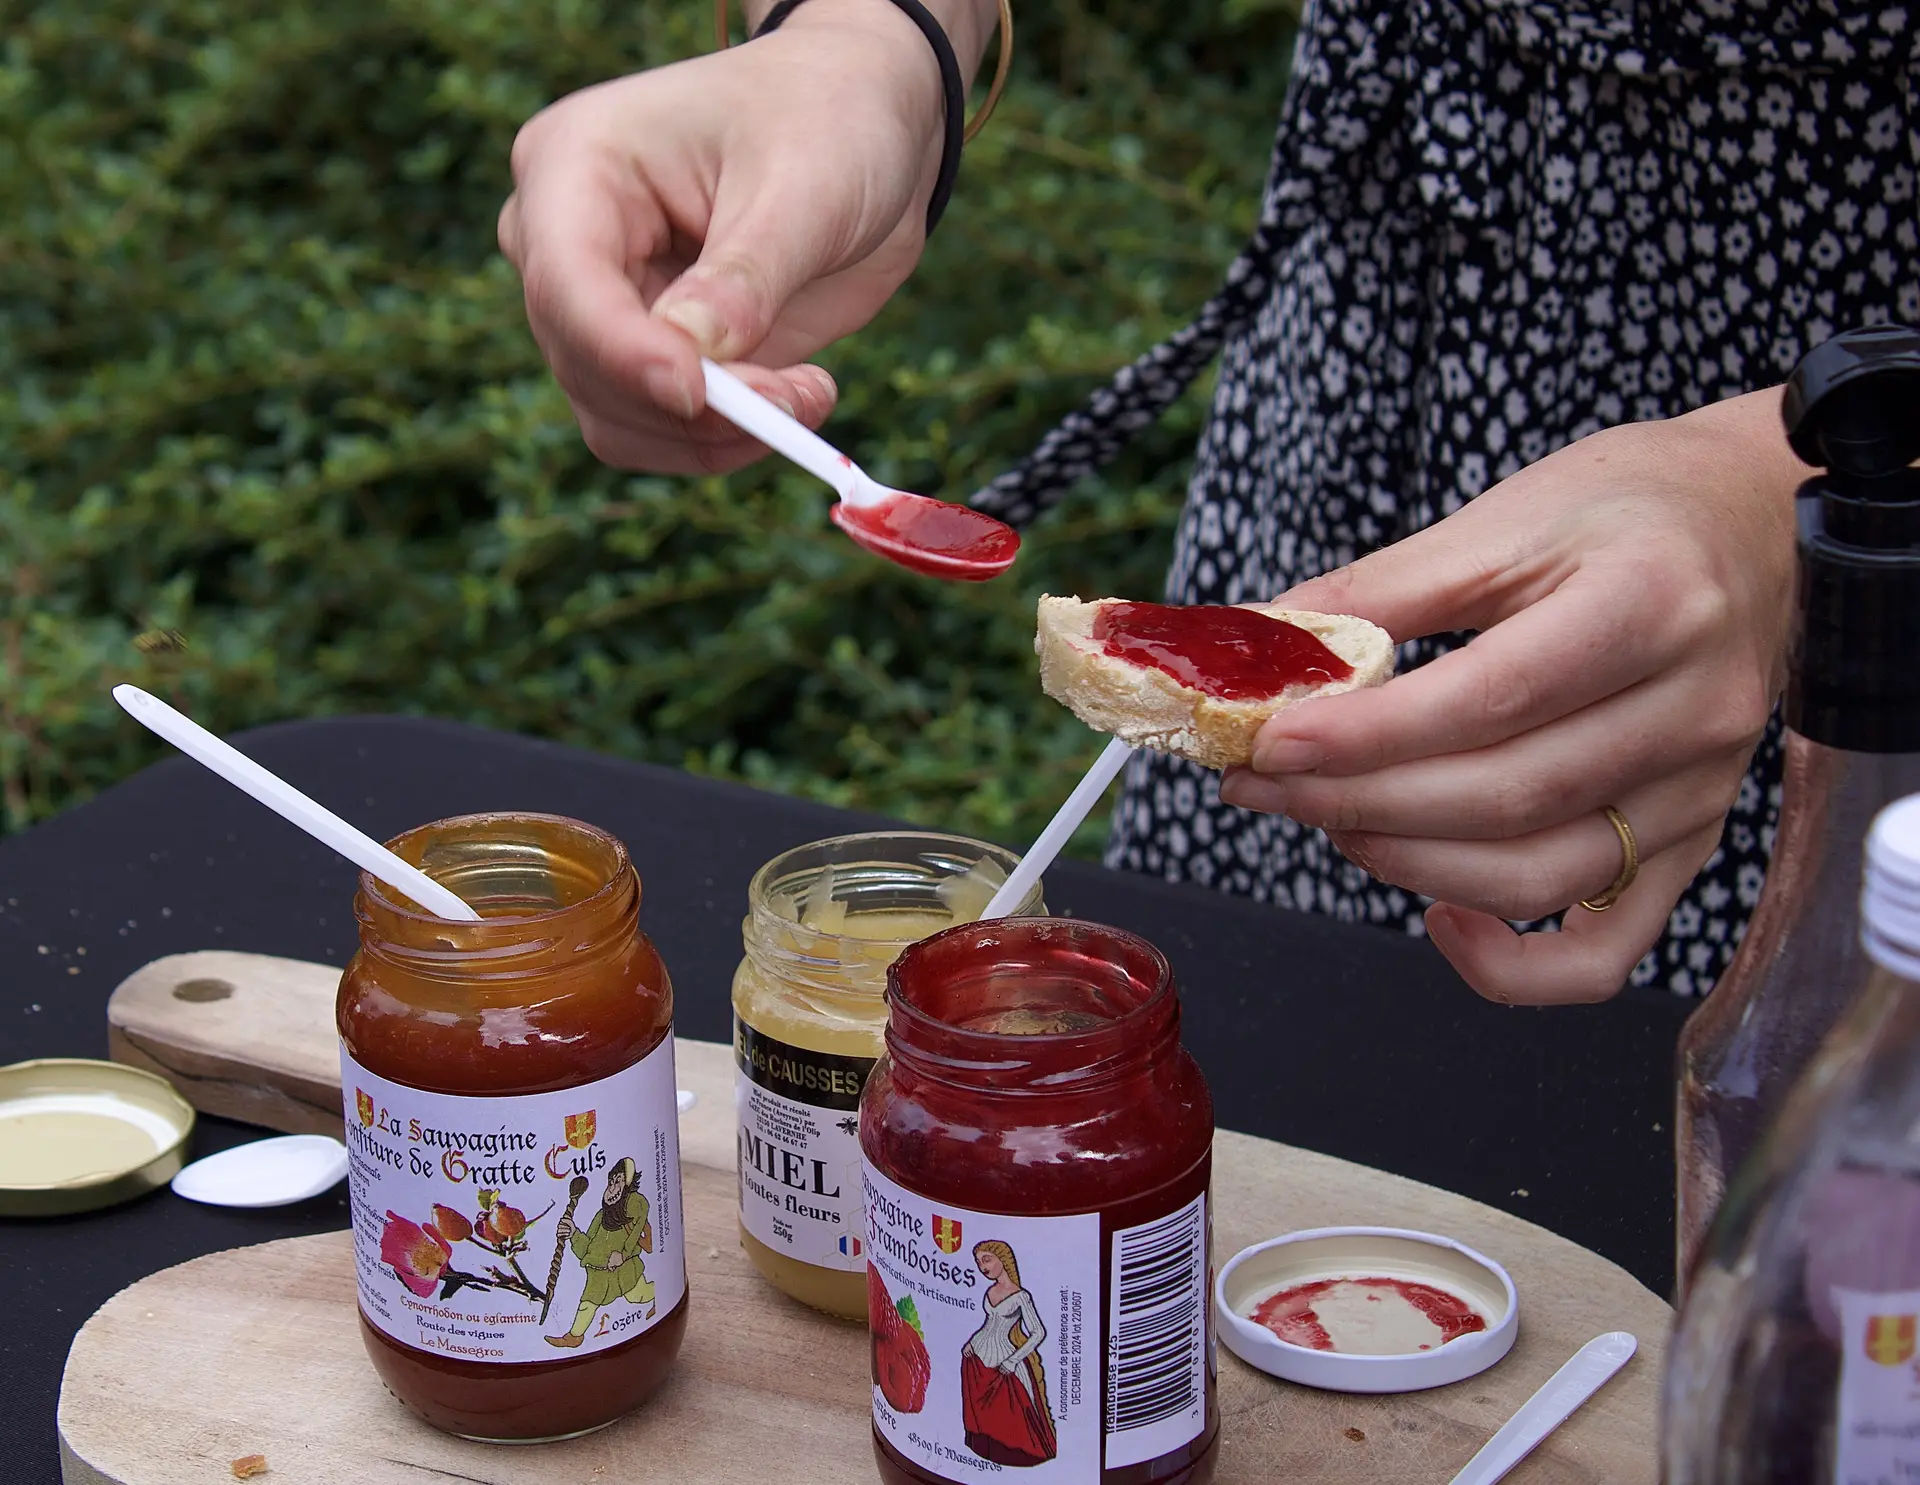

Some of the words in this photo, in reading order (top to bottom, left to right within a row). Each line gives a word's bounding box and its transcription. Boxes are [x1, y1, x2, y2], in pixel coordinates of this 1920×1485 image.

[751, 1045, 766, 1072] de
[768, 1053, 860, 1096] CAUSSES
[756, 1098, 772, 1112] France
[773, 1108, 803, 1125] (Aveyron)
[804, 1120, 815, 1129] par
[763, 1096, 781, 1109] produit
[789, 1107, 811, 1117] récolté
[377, 1108, 402, 1137] La
[408, 1118, 537, 1157] Sauvagine
[771, 1122, 807, 1141] LAVERNHE
[793, 1122, 801, 1131] de
[409, 1147, 433, 1178] de
[441, 1149, 536, 1184] Gratte
[544, 1143, 606, 1180] Culs
[743, 1125, 840, 1199] MIEL
[745, 1171, 780, 1207] toutes
[785, 1194, 841, 1224] fleurs
[863, 1171, 924, 1237] auvagine
[773, 1224, 793, 1243] 250g
[917, 1282, 976, 1311] Artisanale
[1060, 1289, 1069, 1312] avant
[1071, 1291, 1082, 1323] 22/0607
[416, 1314, 446, 1333] Route
[447, 1325, 466, 1337] des
[466, 1313, 480, 1323] ou
[593, 1310, 642, 1338] Lozère
[1071, 1324, 1081, 1334] lot
[420, 1330, 435, 1347] Le
[437, 1336, 504, 1358] Massegros
[1058, 1313, 1070, 1355] préférence
[1071, 1335, 1081, 1355] 2024
[1108, 1335, 1118, 1359] 325
[1058, 1356, 1068, 1366] de
[1060, 1368, 1068, 1413] consommer
[1071, 1357, 1081, 1405] DECEMBRE
[1059, 1413, 1068, 1421] A
[934, 1442, 943, 1455] le
